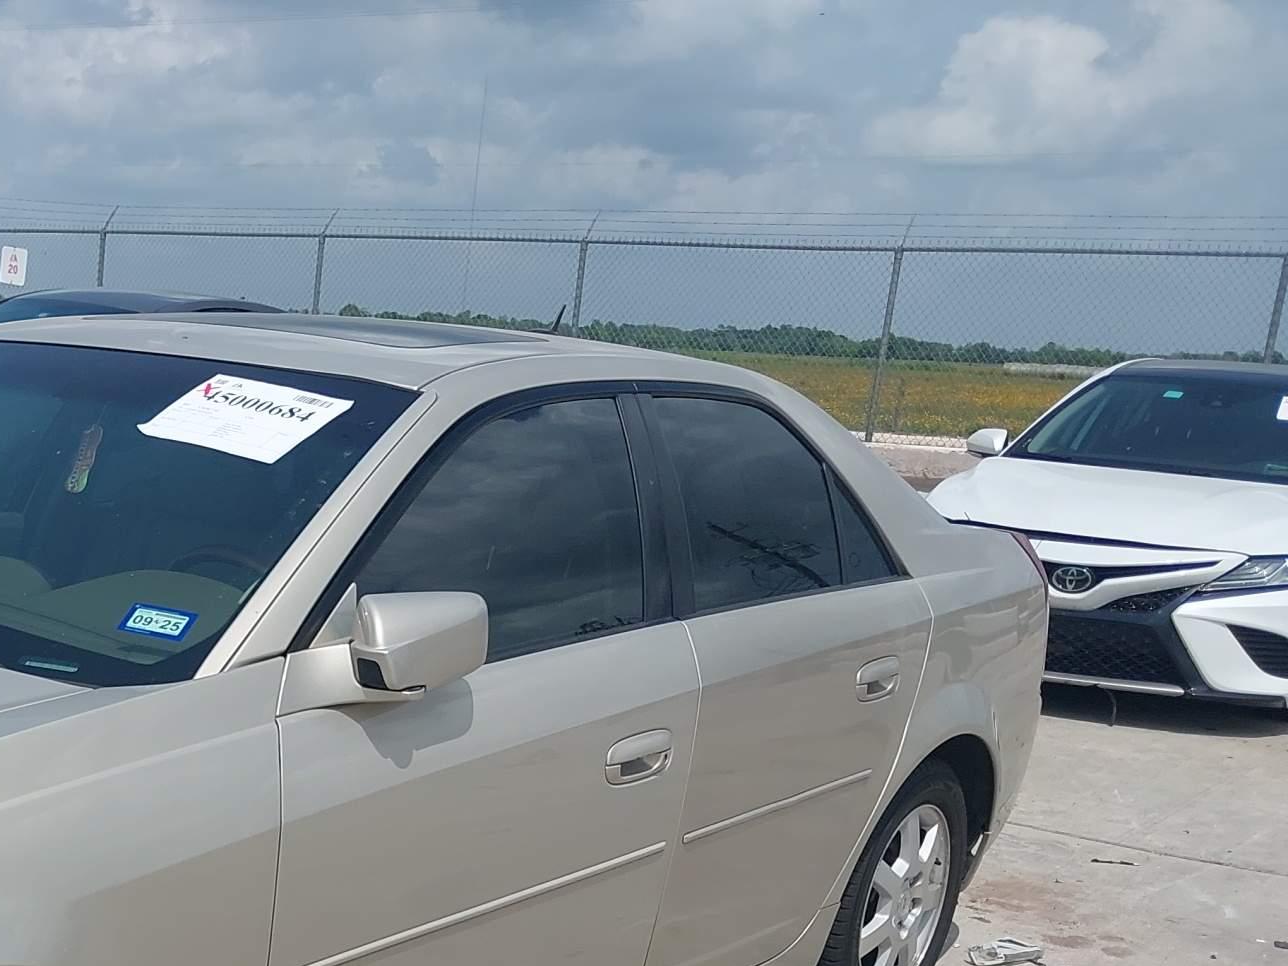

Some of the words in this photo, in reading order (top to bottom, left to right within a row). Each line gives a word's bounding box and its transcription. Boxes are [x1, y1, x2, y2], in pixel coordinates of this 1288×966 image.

[203, 390, 316, 422] 45000684
[132, 614, 154, 626] 09
[159, 619, 182, 631] 25
